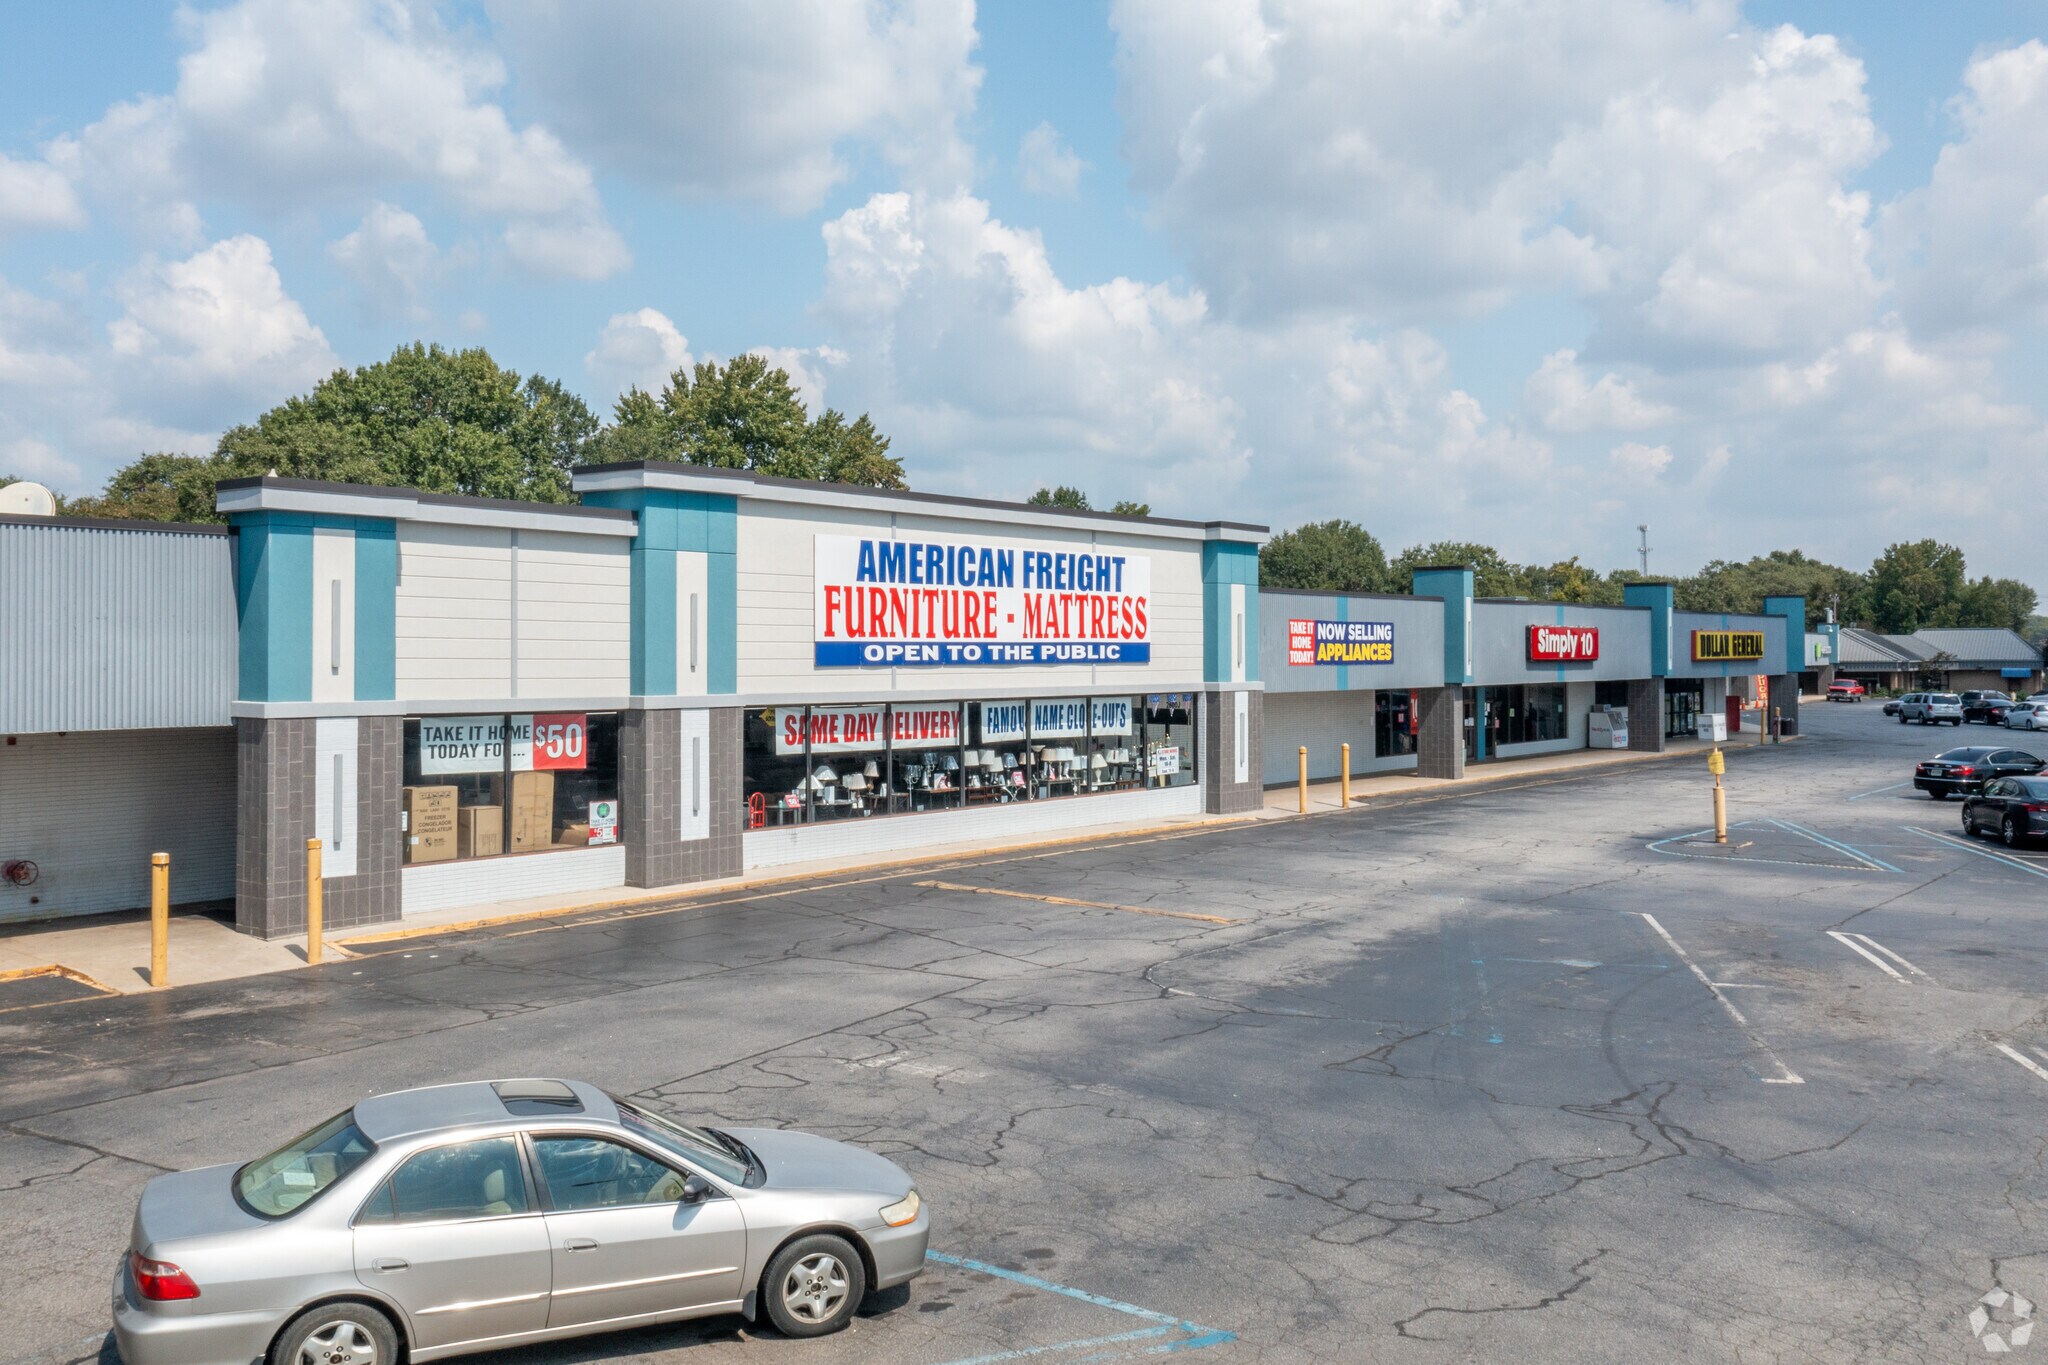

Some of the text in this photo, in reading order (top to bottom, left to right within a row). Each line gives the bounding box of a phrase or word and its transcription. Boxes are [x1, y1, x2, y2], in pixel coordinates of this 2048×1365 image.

[856, 540, 1126, 593] AMERICAN FREIGHT
[823, 585, 997, 639] FURNITURE
[1022, 592, 1147, 640] MATTRESS
[1289, 621, 1314, 634] TAKE IT
[1317, 623, 1392, 641] NOW SELLING
[1292, 636, 1312, 649] HOME
[1317, 642, 1392, 661] APPLIANCES
[1538, 628, 1593, 658] Simply 10
[1700, 634, 1763, 657] DOLLAR GENERAL
[863, 644, 1121, 662] OPEN TO THE PUBLIC
[1289, 650, 1314, 663] TODAY!
[1035, 704, 1064, 730] NAME
[1067, 702, 1127, 730] CLOE-OUTS
[423, 725, 530, 742] TAKE IT HOME
[784, 713, 838, 746] SAME
[844, 712, 879, 743] DAY
[535, 723, 583, 759] $50
[428, 743, 478, 759] TODAY
